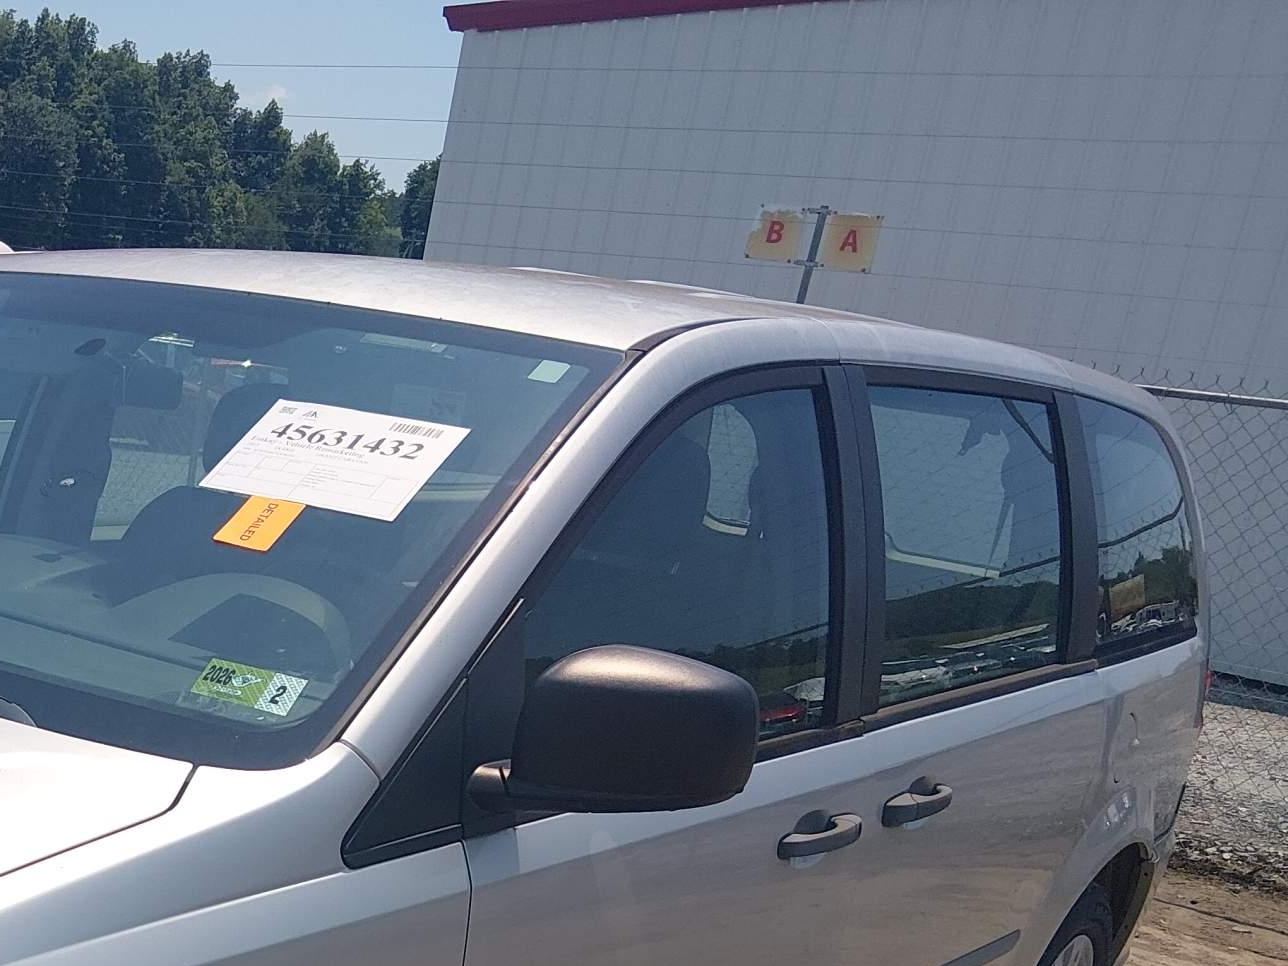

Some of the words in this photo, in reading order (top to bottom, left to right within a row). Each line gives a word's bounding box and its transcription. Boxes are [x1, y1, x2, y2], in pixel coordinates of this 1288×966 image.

[765, 220, 785, 244] B
[839, 229, 858, 253] A
[270, 421, 425, 460] 45631432
[239, 502, 279, 541] DETAILED
[202, 664, 236, 686] 2026
[268, 685, 288, 705] 2
